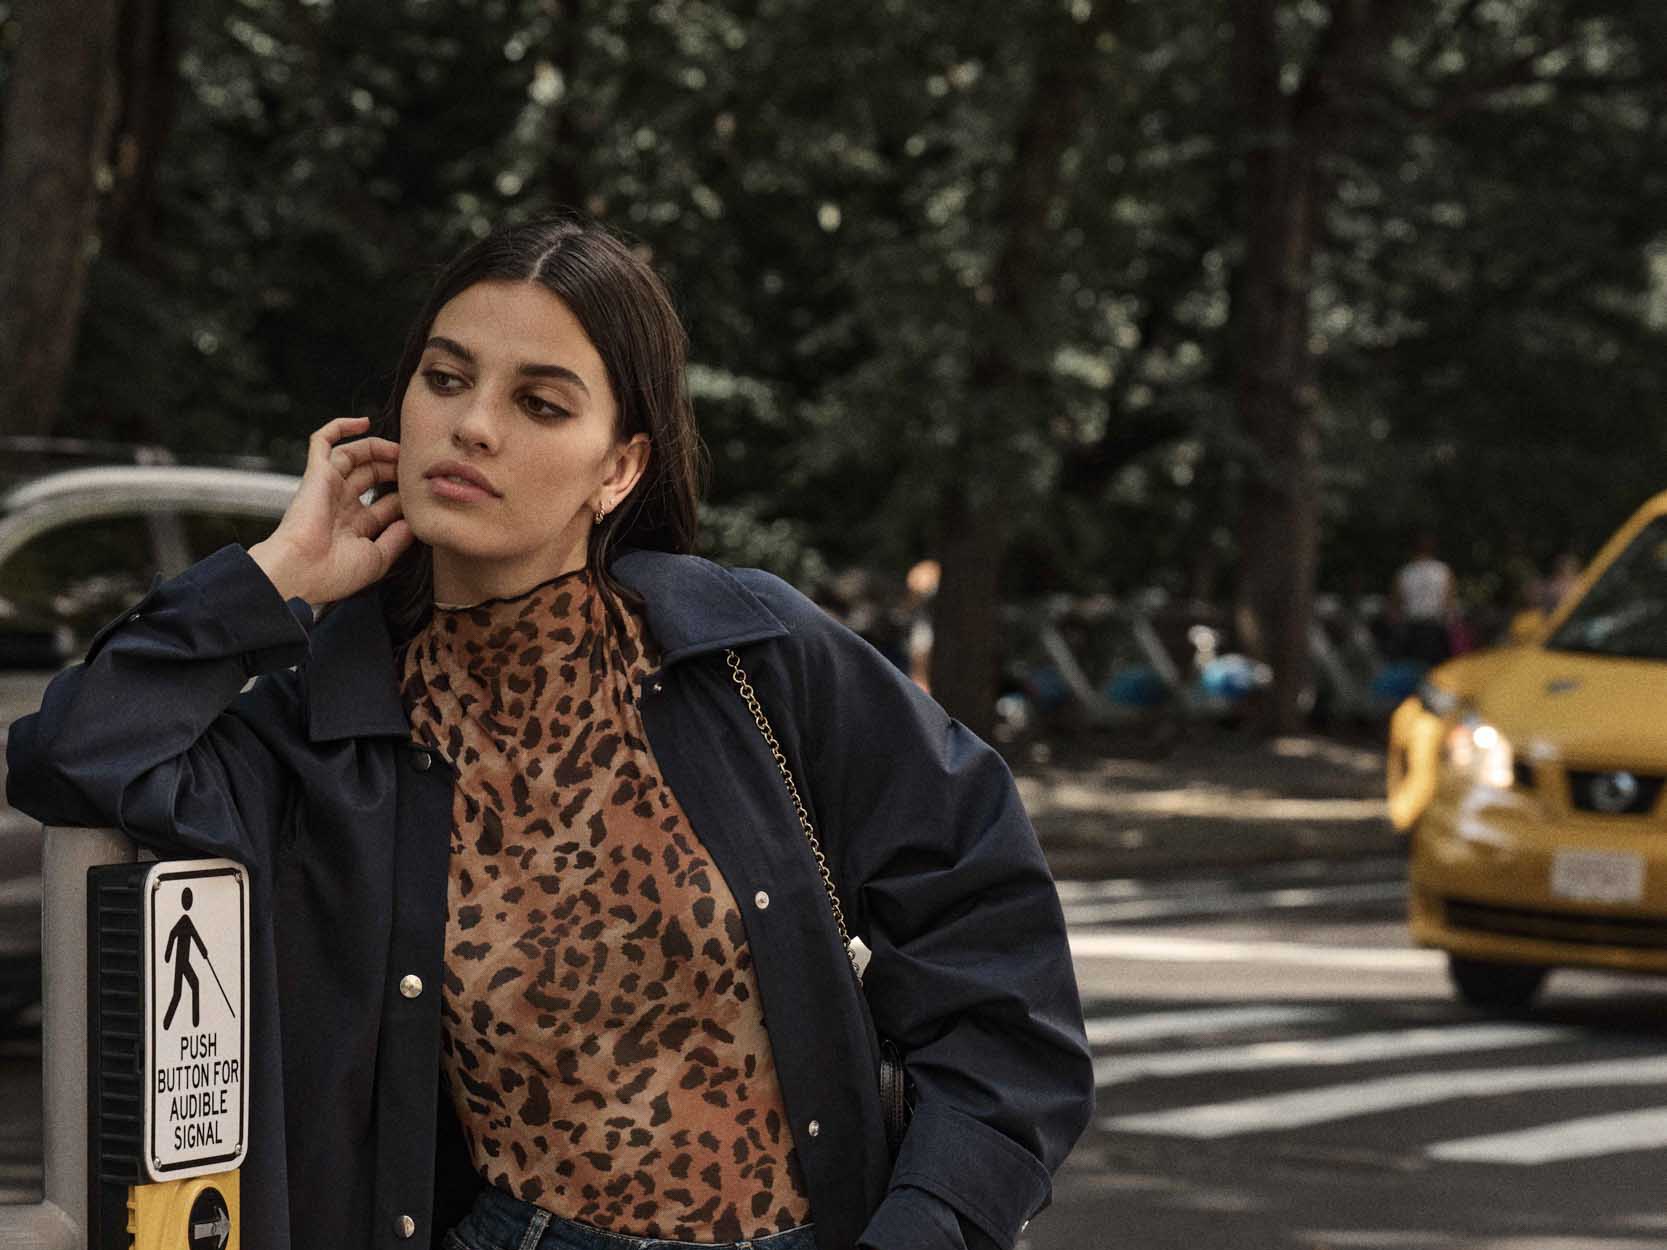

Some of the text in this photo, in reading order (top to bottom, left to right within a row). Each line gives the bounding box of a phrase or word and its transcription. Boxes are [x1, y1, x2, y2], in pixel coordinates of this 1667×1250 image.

[180, 1033, 217, 1061] PUSH
[158, 1059, 239, 1093] BUTTON FOR
[169, 1090, 228, 1122] AUDIBLE
[174, 1120, 222, 1150] SIGNAL
